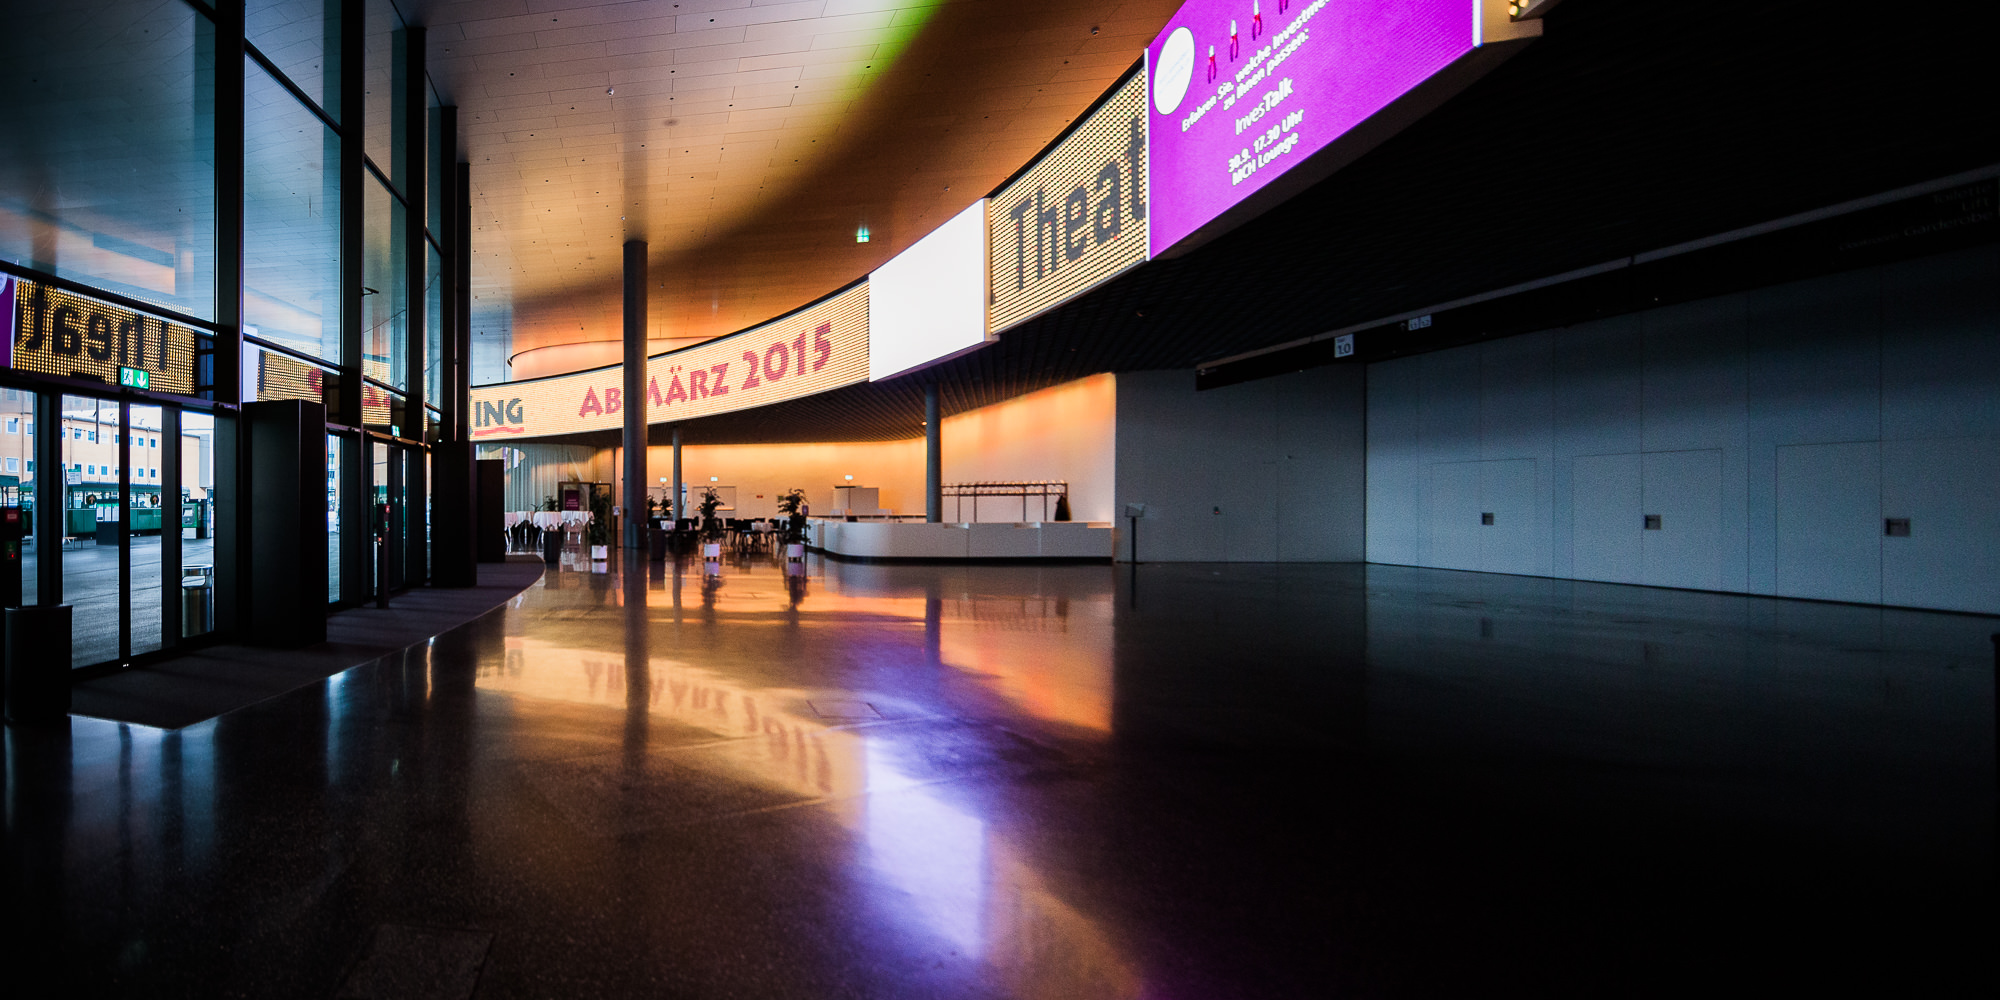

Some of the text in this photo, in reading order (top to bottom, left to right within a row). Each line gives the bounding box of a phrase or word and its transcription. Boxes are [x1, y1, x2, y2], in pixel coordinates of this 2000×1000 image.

[1182, 96, 1217, 132] Erfahren
[1235, 46, 1271, 83] welche
[1272, 0, 1330, 49] Investme
[1223, 28, 1309, 111] zu Ihnen passen:
[1235, 77, 1294, 135] InvesTalk
[1253, 124, 1280, 153] 17.30
[1281, 109, 1304, 133] Uhr
[1232, 132, 1299, 186] MCH Lounge
[1904, 211, 1993, 237] Garderobe
[470, 395, 523, 432] ING
[578, 386, 622, 418] AB
[741, 321, 832, 391] 2015
